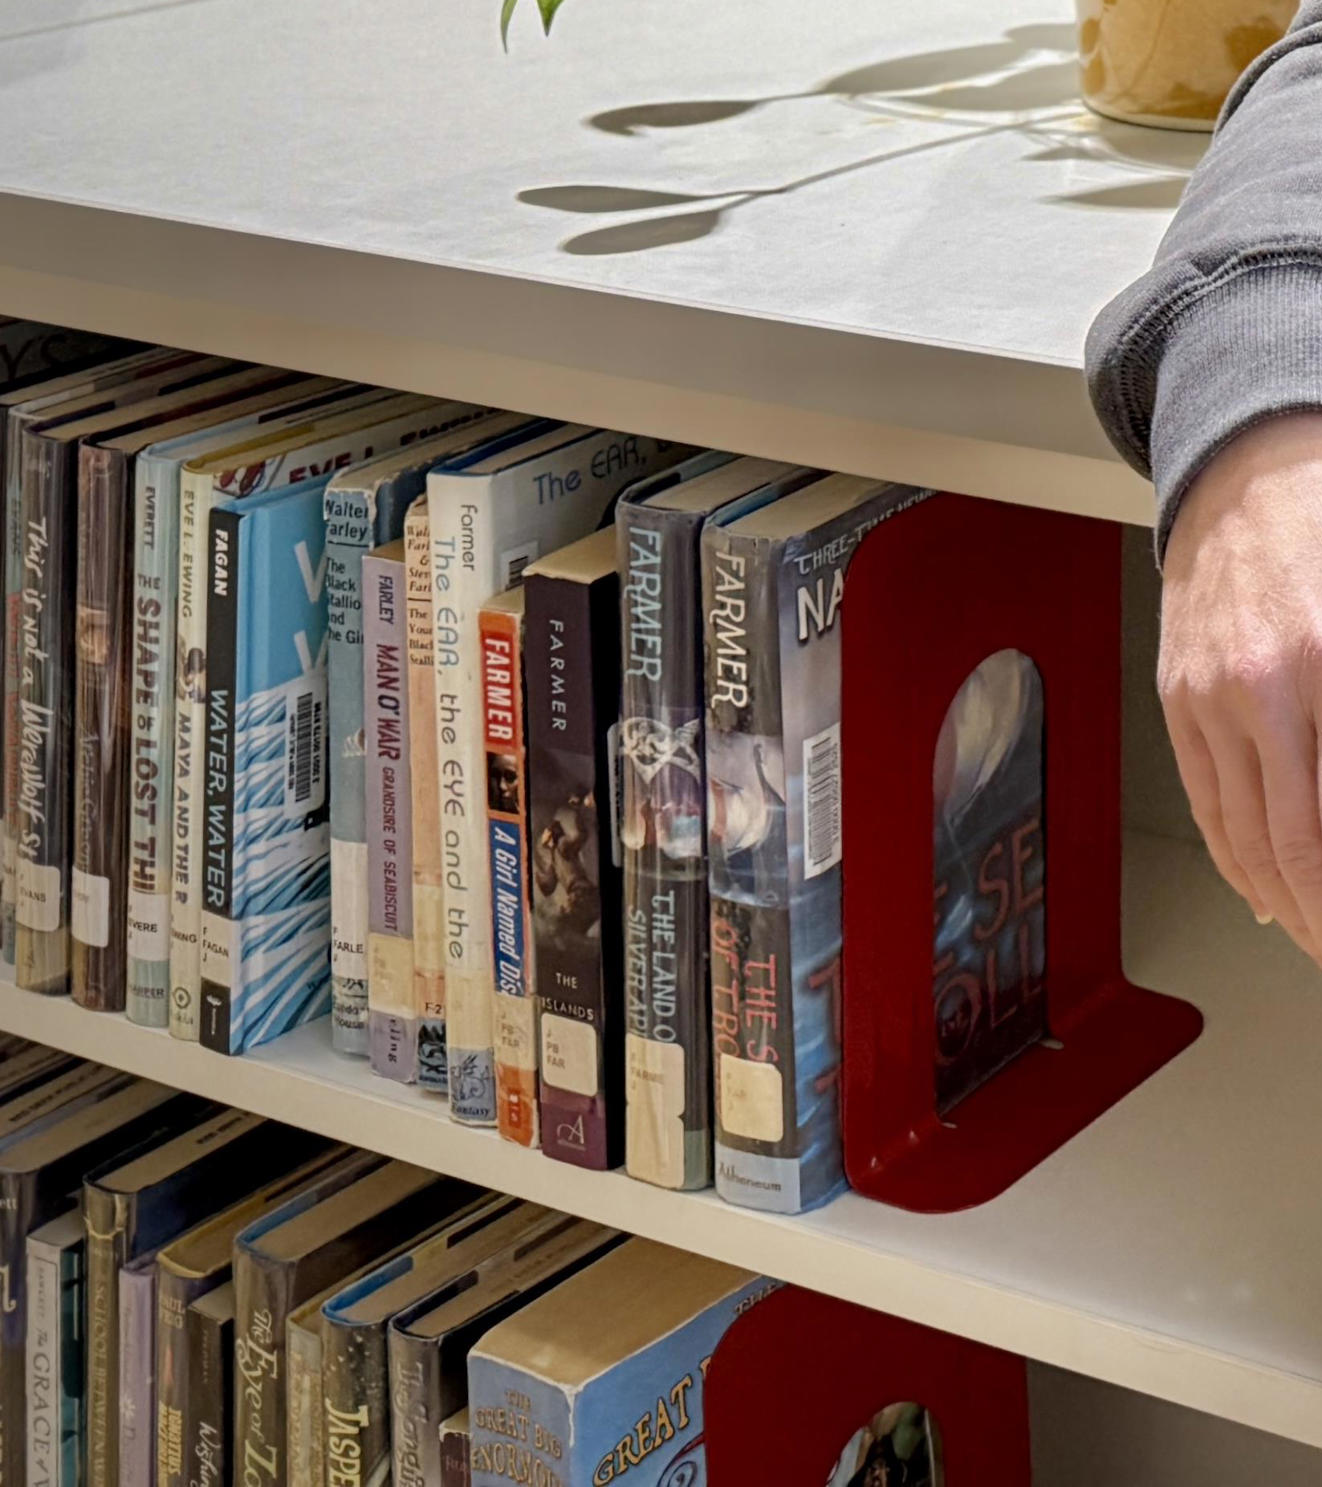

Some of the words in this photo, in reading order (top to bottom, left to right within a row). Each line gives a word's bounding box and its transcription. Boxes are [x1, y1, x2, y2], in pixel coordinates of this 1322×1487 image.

[182, 489, 195, 526] EVE
[532, 468, 582, 506] The
[143, 486, 156, 551] EVERETT
[328, 521, 368, 542] arley
[137, 574, 162, 591] THE
[181, 556, 195, 619] EWING
[213, 528, 229, 597] FAGAN
[435, 536, 456, 592] The
[377, 575, 394, 625] FARLEY
[622, 526, 663, 682] FARMER
[708, 551, 750, 709] FARMER
[796, 565, 845, 642] NA
[136, 598, 162, 706] SHAPE
[376, 643, 401, 693] MAN
[436, 607, 460, 676] EAR,
[485, 636, 513, 742] FARMER
[549, 618, 567, 732] FARMER
[136, 714, 153, 732] OF
[176, 713, 192, 779] MAYA
[207, 688, 229, 797] WATER,
[440, 692, 462, 745] the
[133, 736, 159, 825] LOST
[382, 766, 397, 833] GRANDSIRE
[441, 758, 466, 818] EYE
[175, 786, 192, 840] AND
[495, 826, 518, 845] A
[19, 829, 42, 862] St
[174, 842, 190, 886] THE
[207, 804, 227, 909] WATER
[383, 838, 397, 856] OF
[445, 834, 468, 891] and
[495, 849, 518, 883] Girl
[382, 861, 399, 932] SEABISCUIT
[496, 888, 520, 964] Named
[652, 889, 677, 946] THE
[202, 939, 230, 959] FAGAN
[447, 908, 471, 960] the
[628, 903, 648, 992] SILVER
[498, 967, 523, 998] Dis
[540, 995, 595, 1021] ISLANDS
[555, 971, 578, 990] THE
[653, 951, 677, 1017] LAND
[744, 954, 778, 1031] THE
[711, 982, 742, 1060] TRO
[32, 1350, 50, 1451] GRACE
[591, 1375, 694, 1487] GREAT
[323, 1397, 370, 1487] JASPE
[474, 1406, 530, 1442] GREAT
[534, 1422, 563, 1459] BIG
